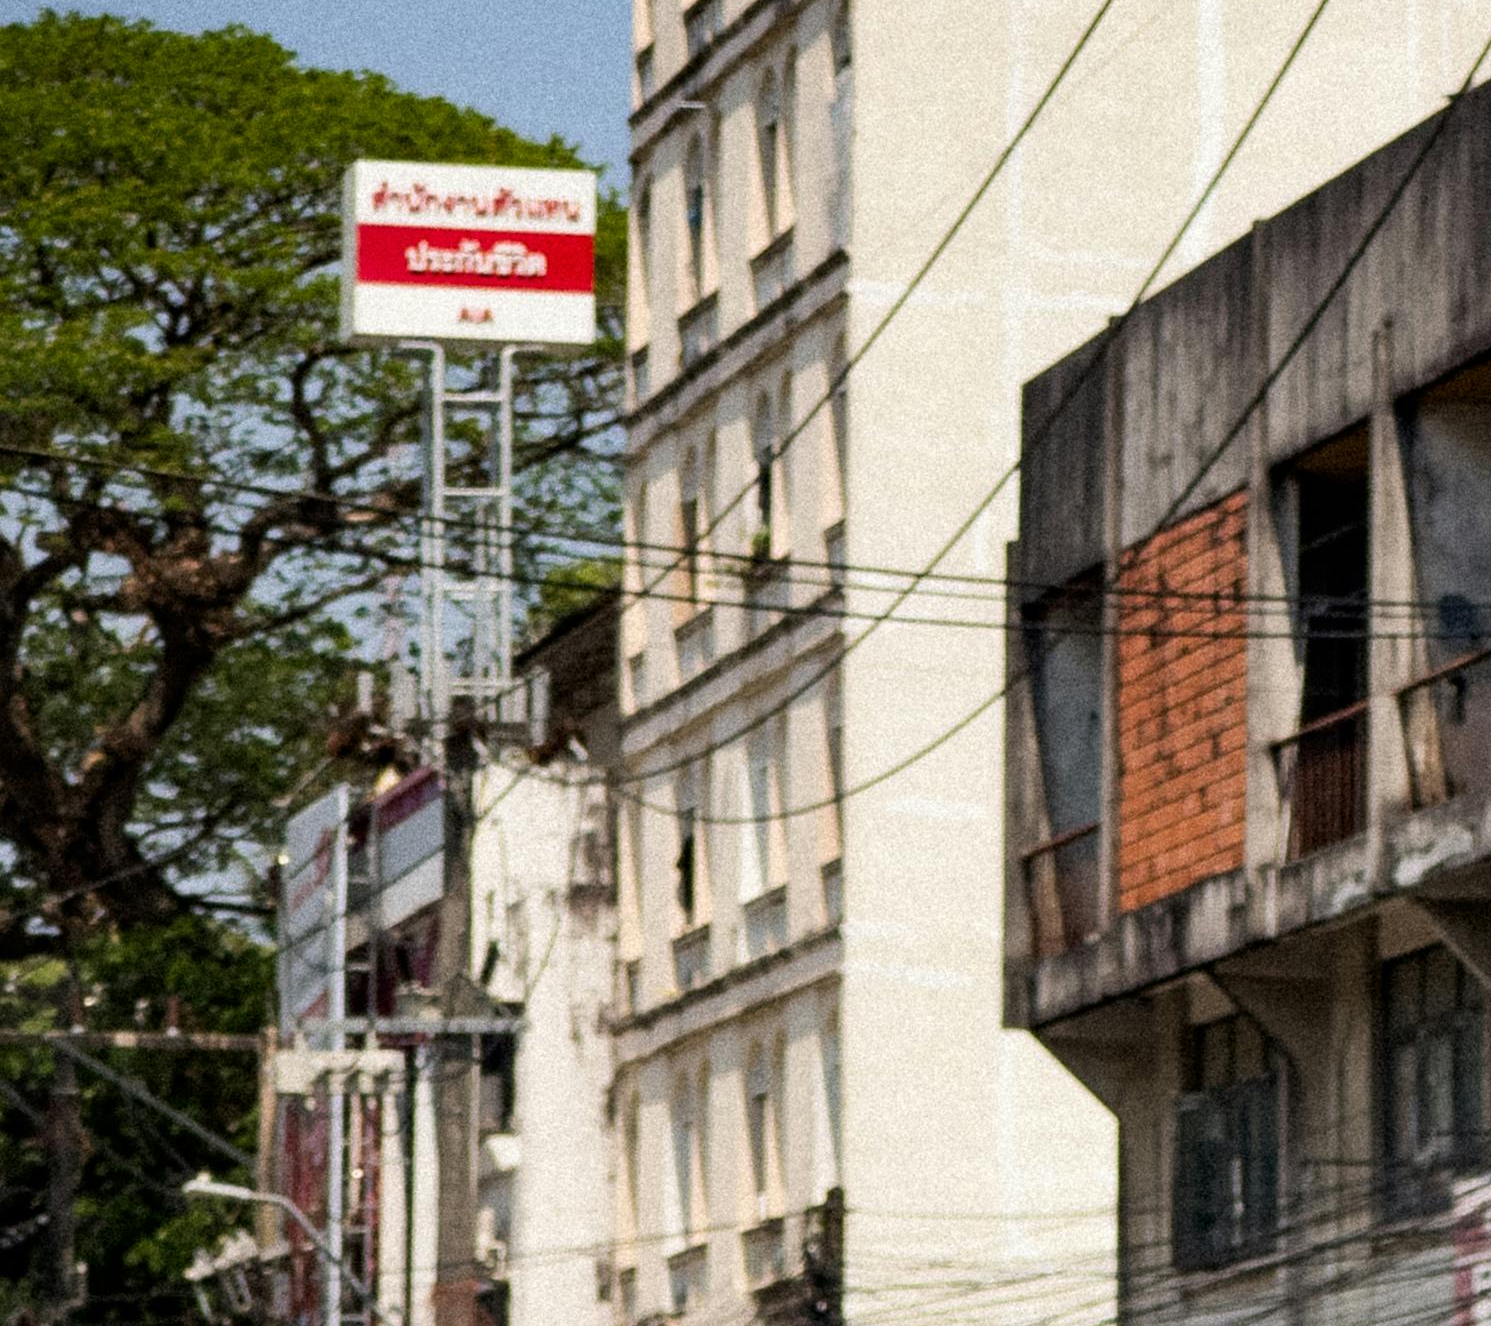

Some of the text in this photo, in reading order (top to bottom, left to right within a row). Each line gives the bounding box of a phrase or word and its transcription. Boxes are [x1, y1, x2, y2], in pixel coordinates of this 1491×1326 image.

[404, 237, 548, 277] ประกันชีวิต
